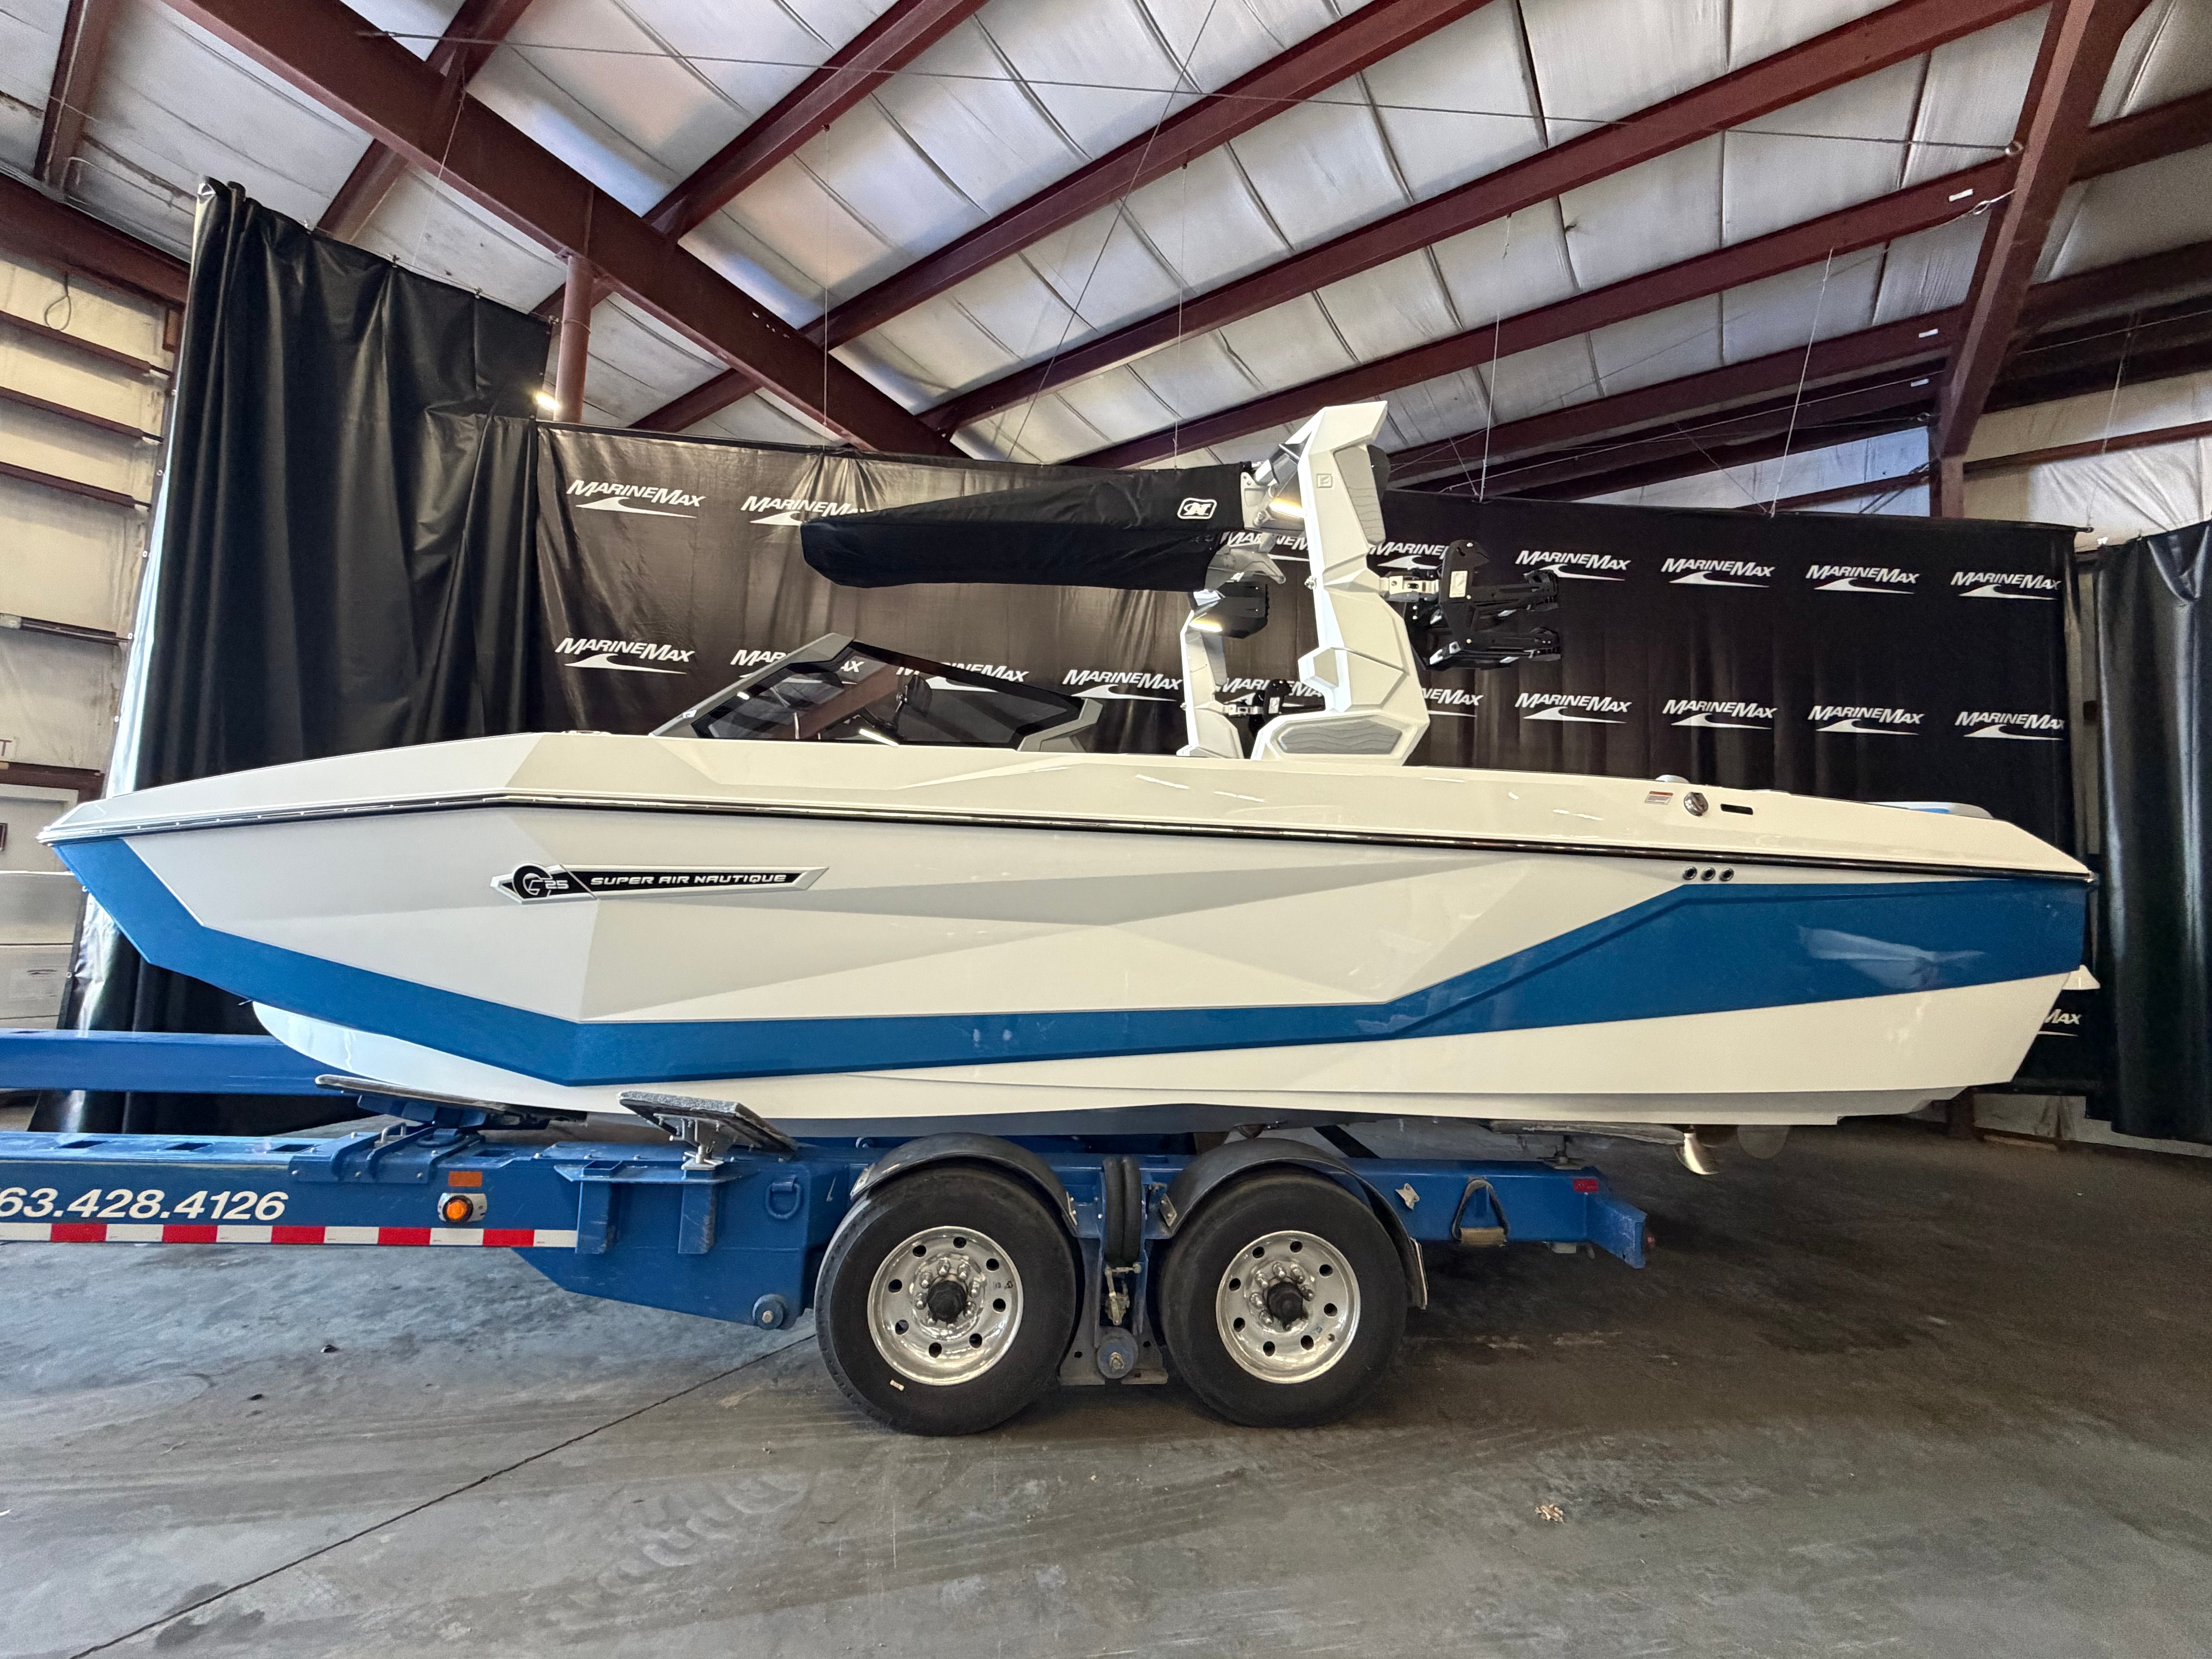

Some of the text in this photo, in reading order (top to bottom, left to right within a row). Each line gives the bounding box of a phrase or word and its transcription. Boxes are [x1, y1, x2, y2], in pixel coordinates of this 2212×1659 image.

[740, 495, 874, 517] MARINEM
[1369, 542, 1449, 560] MARINE
[591, 876, 654, 885] SUPER
[658, 876, 690, 884] AIR
[694, 875, 787, 883] NAUTIQUE
[0, 1187, 289, 1221] 63.428.4126
